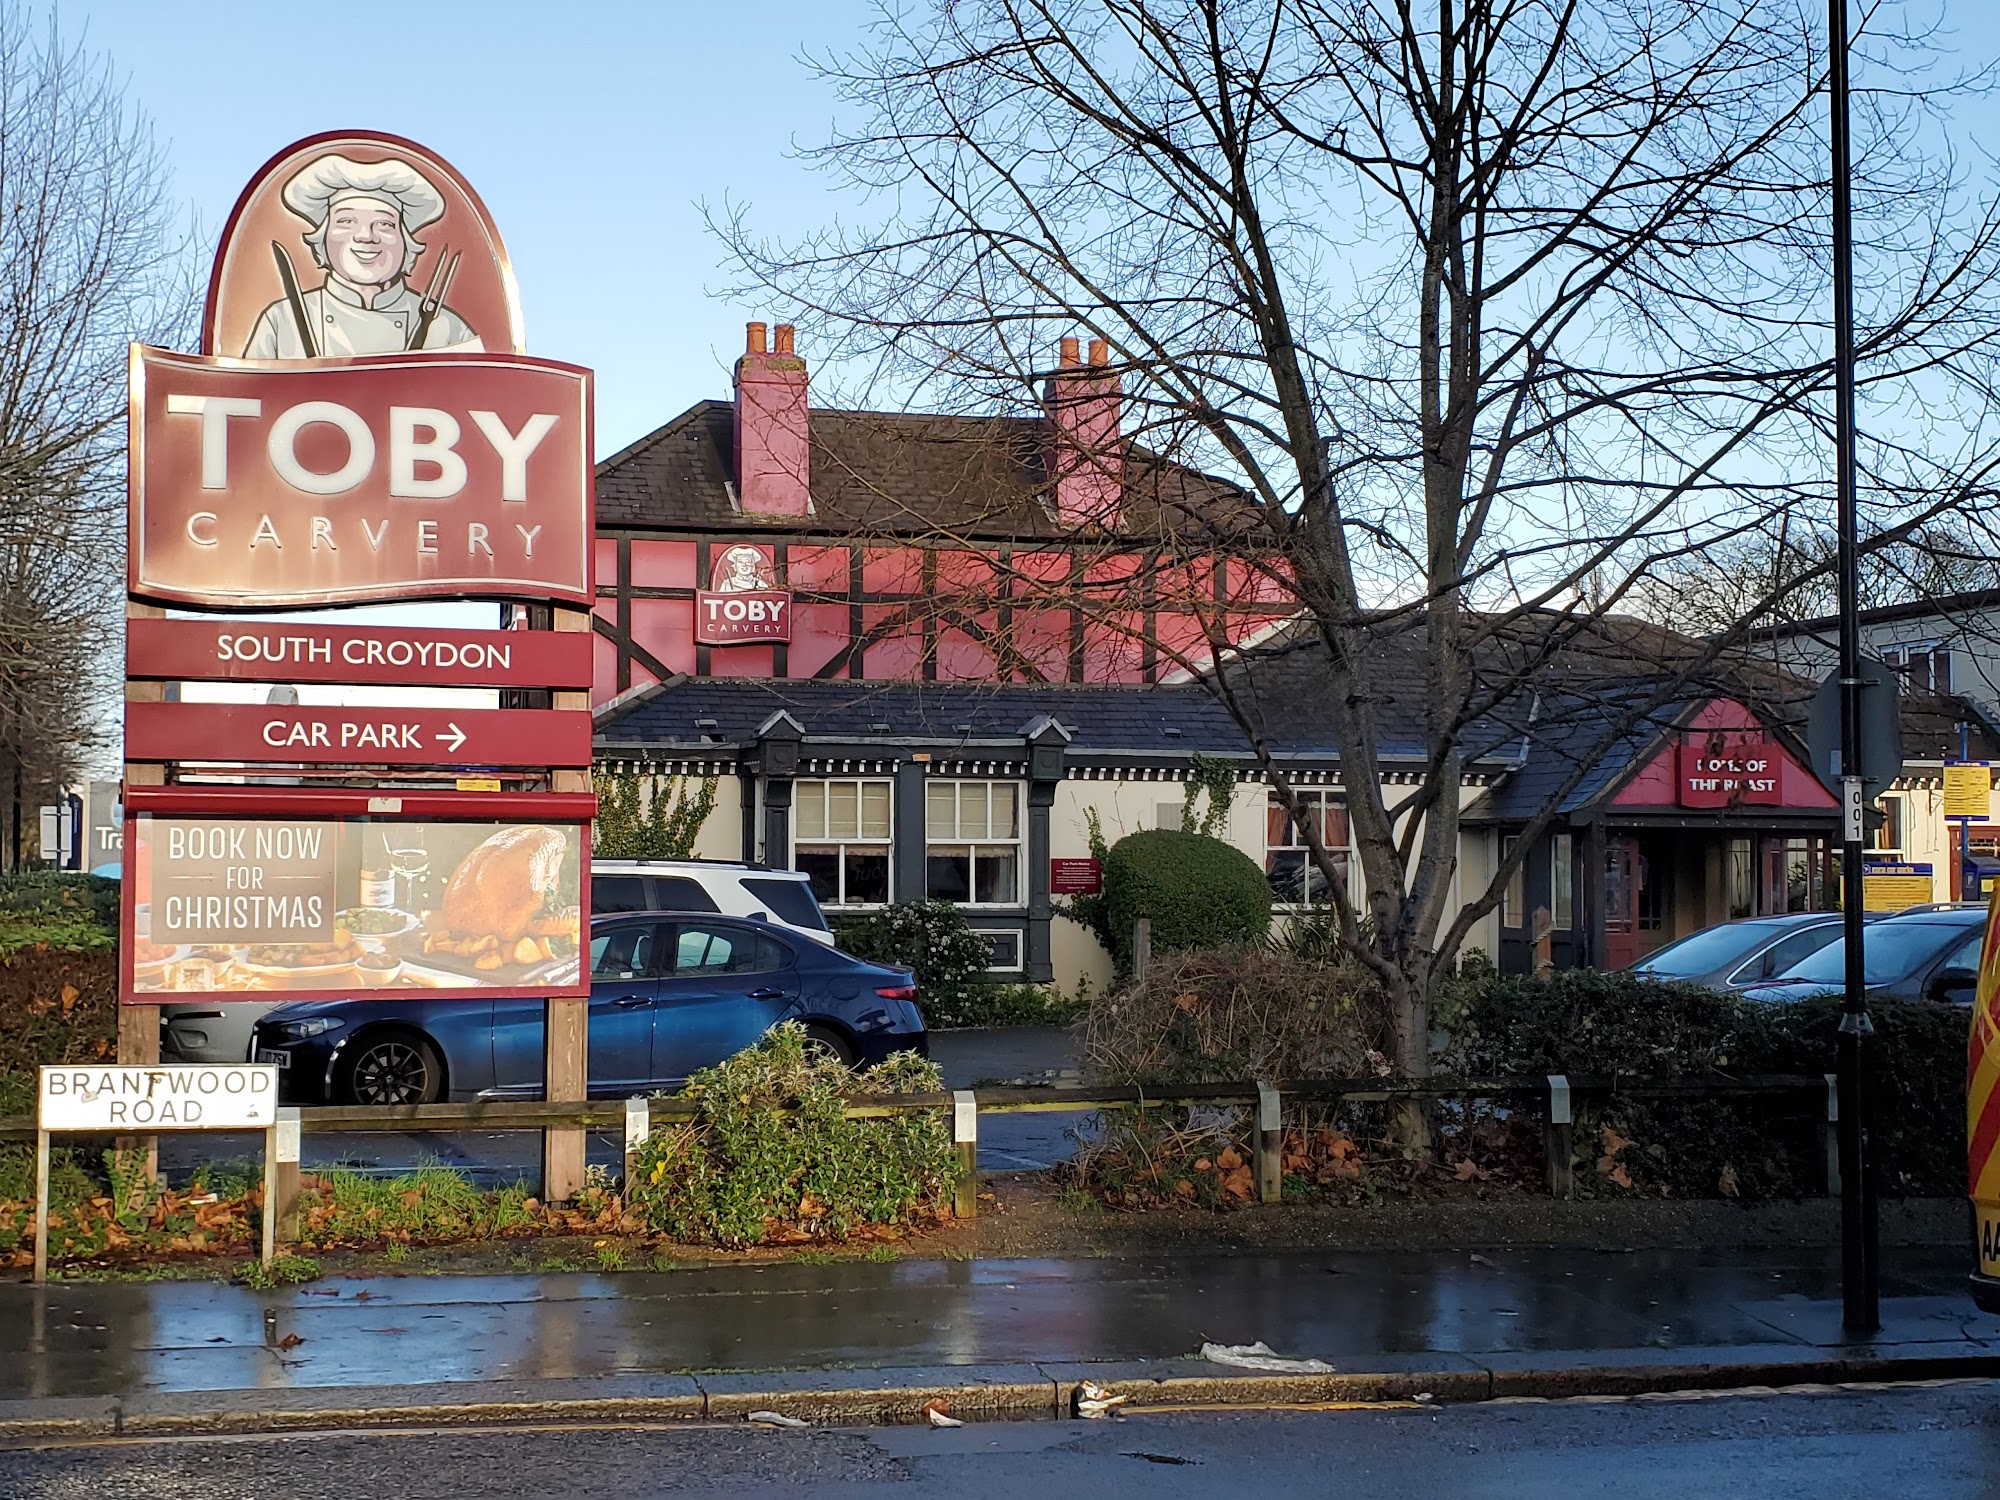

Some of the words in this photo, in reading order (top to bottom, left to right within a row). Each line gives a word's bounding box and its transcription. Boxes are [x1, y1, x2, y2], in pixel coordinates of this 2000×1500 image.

[167, 394, 560, 502] TOBY
[186, 512, 542, 557] CARVERY
[703, 599, 786, 622] TOBY
[706, 623, 782, 634] CARVERY
[216, 634, 331, 663] SOUTH
[342, 639, 511, 669] CROYDON
[262, 720, 332, 748] CAR
[341, 722, 423, 749] PARK
[1746, 760, 1768, 772] OF
[1853, 791, 1861, 838] 001
[169, 827, 247, 860] BOOK
[255, 827, 323, 860] NOW
[226, 866, 263, 890] FOR
[166, 896, 322, 929] CHRISTMAS
[49, 1071, 270, 1097] BRANTWOOD
[110, 1100, 203, 1123] ROAD
